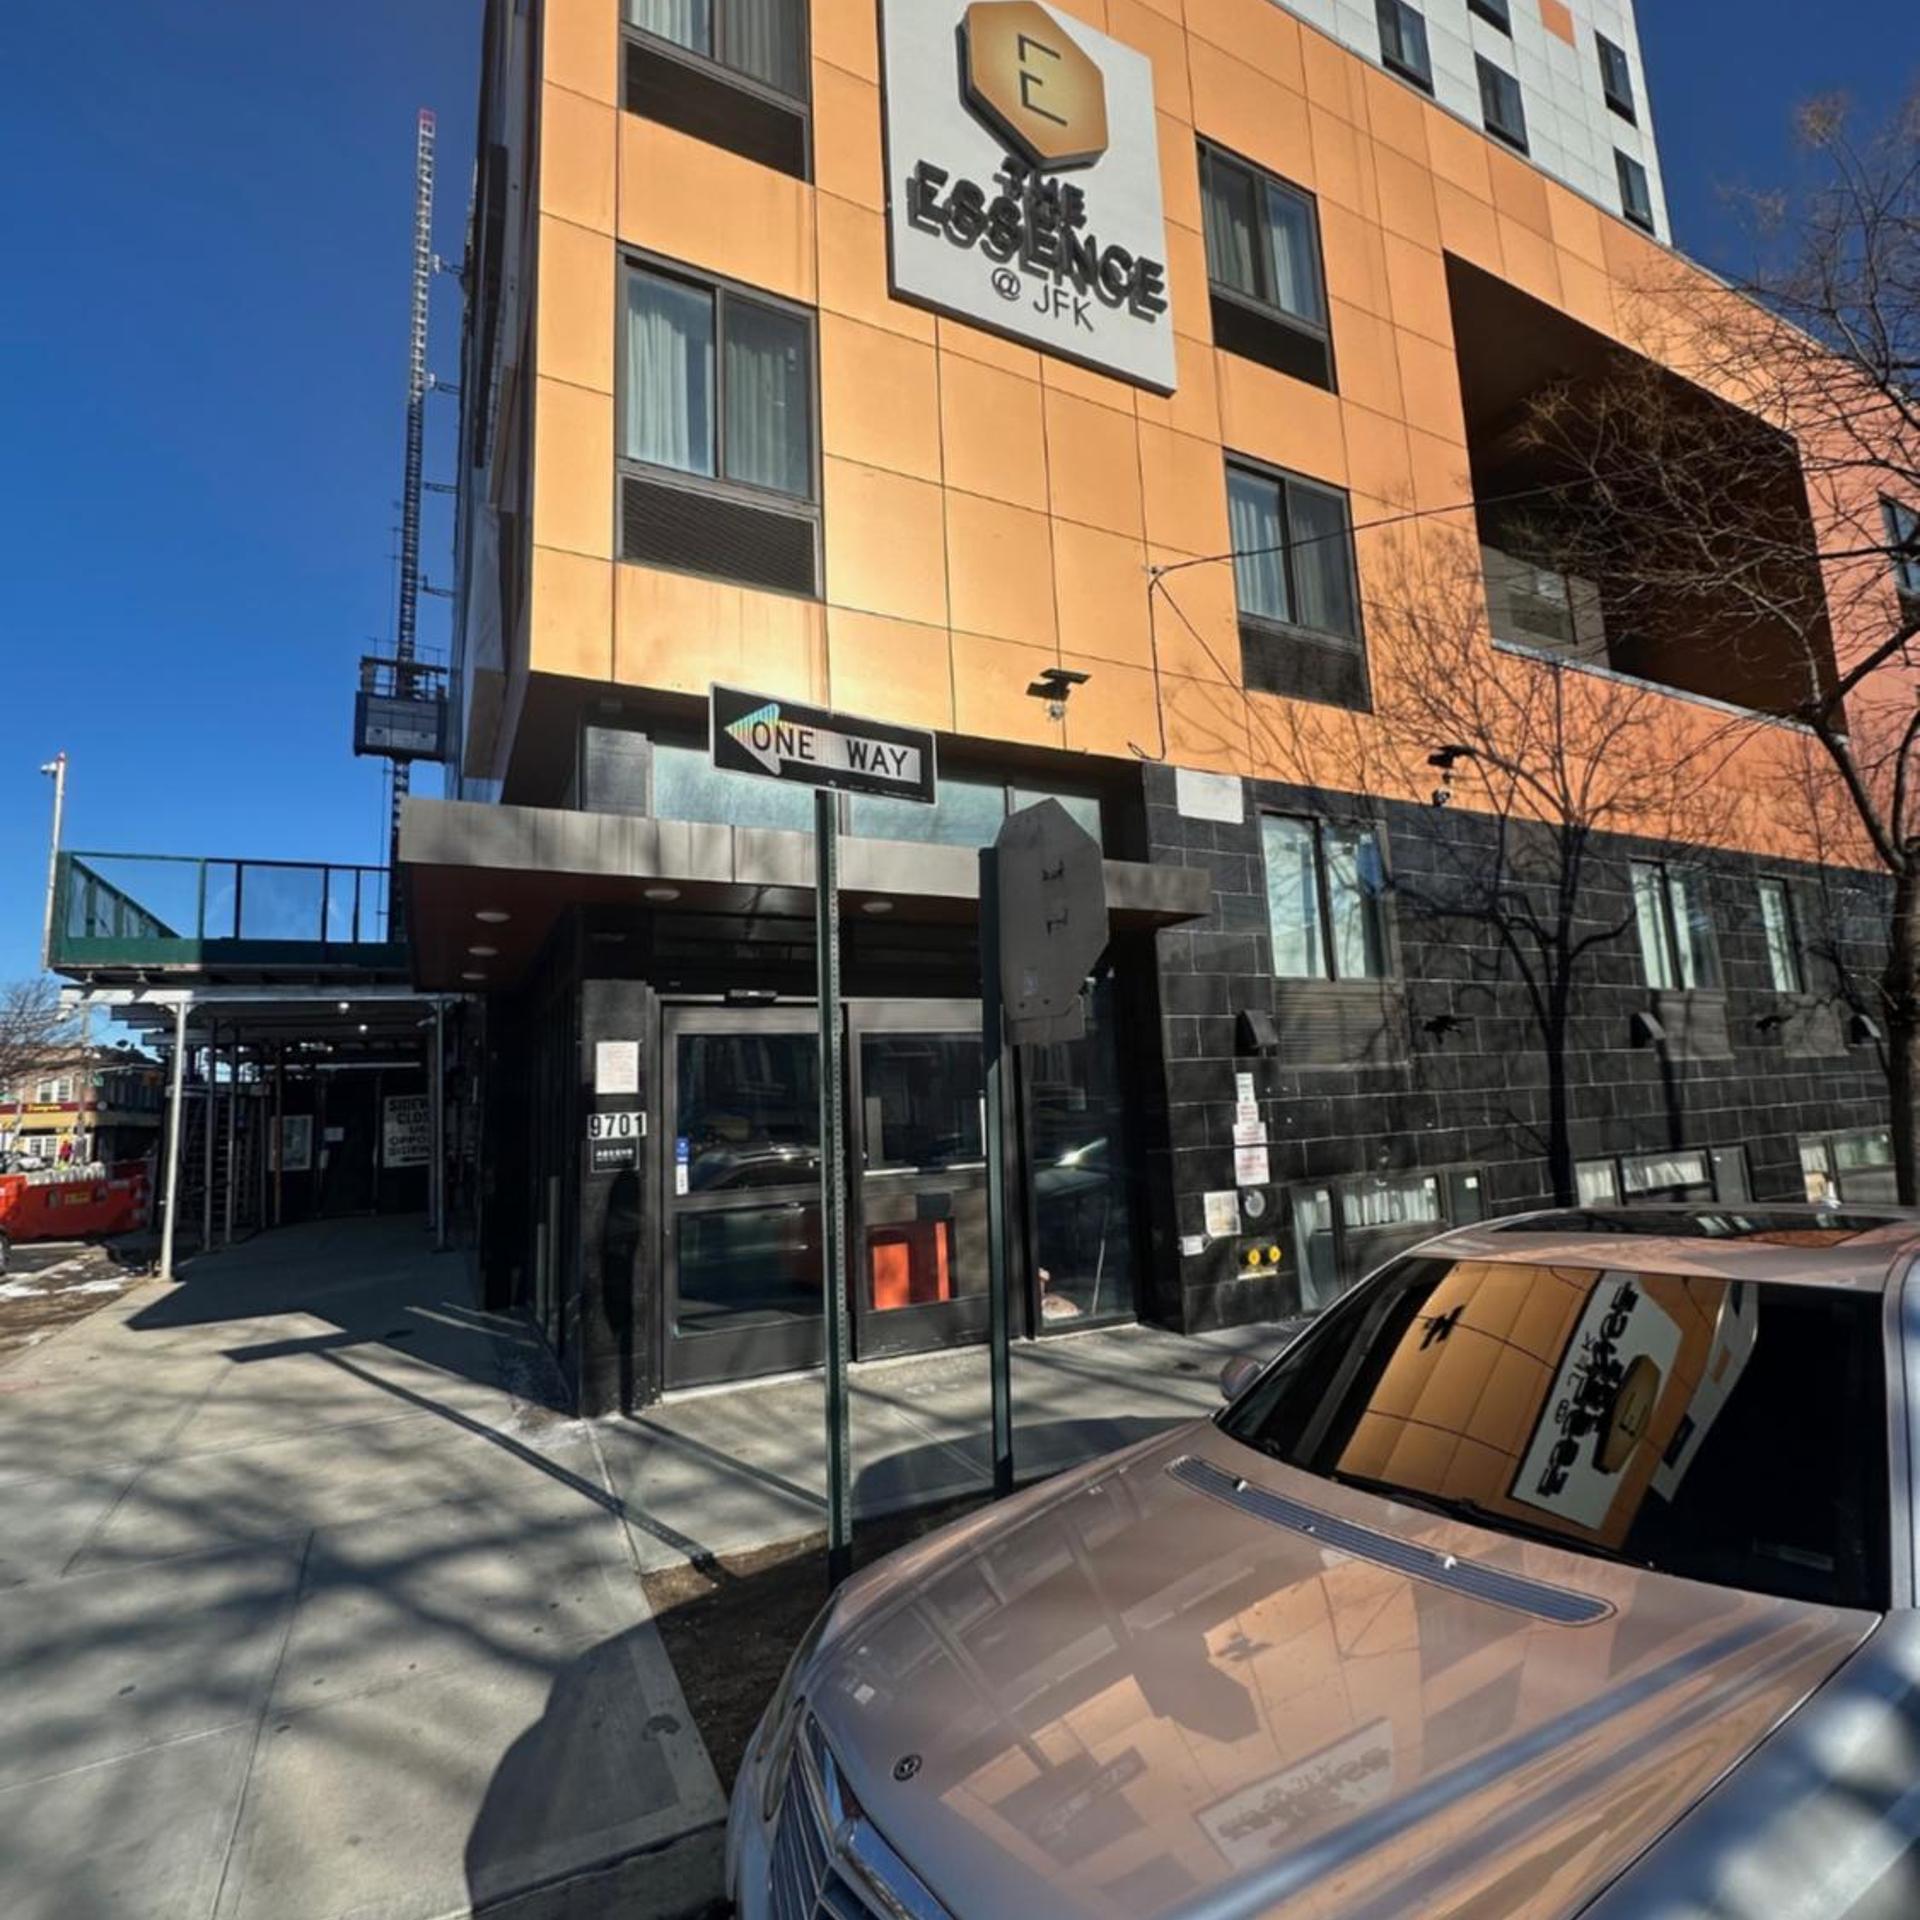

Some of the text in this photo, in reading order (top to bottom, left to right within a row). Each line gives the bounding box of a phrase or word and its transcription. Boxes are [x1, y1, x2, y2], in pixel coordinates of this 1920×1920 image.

[1017, 33, 1068, 127] E
[906, 159, 1168, 324] ESSENCE
[991, 267, 1094, 332] @ JFK
[752, 721, 908, 777] ONE WAY
[590, 1113, 643, 1137] 9701
